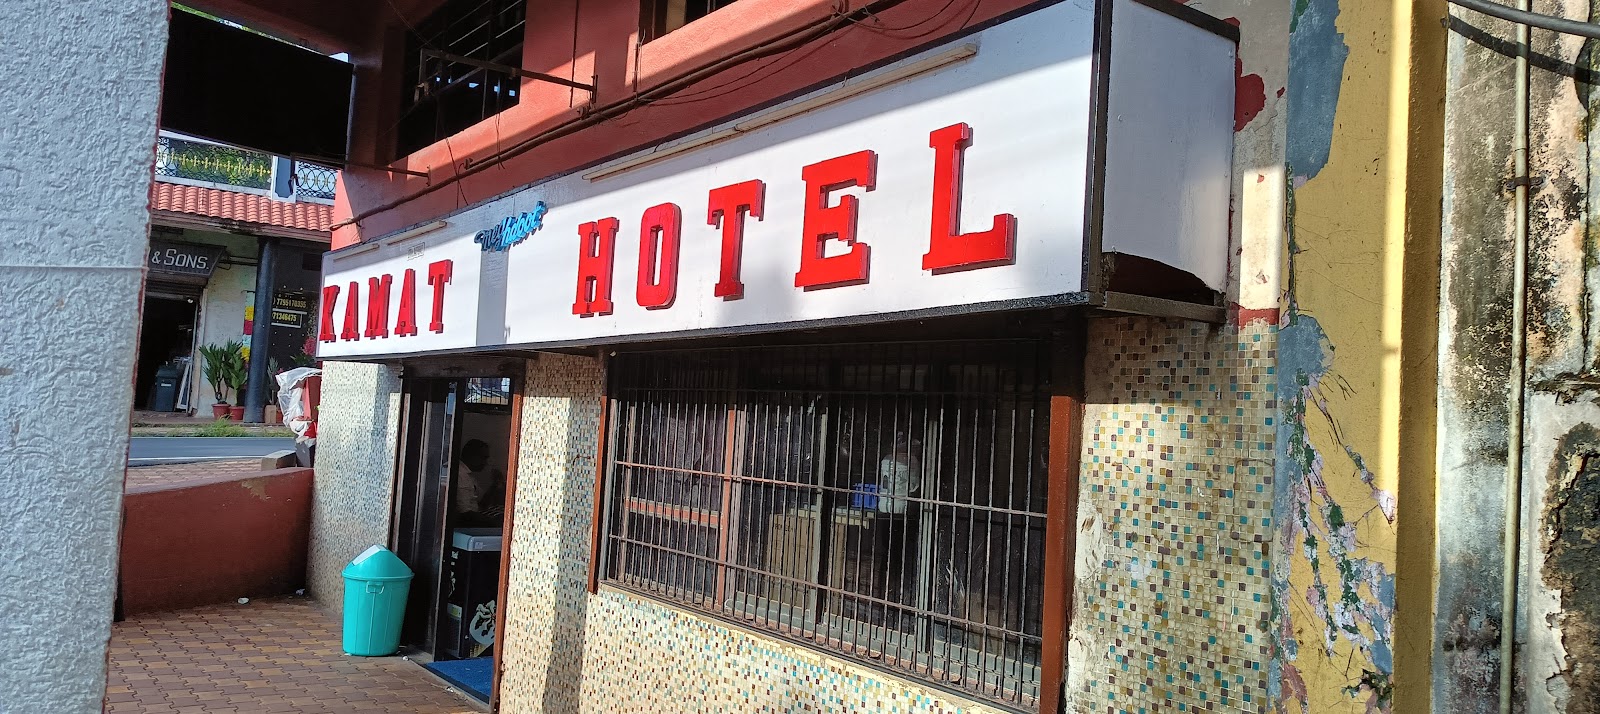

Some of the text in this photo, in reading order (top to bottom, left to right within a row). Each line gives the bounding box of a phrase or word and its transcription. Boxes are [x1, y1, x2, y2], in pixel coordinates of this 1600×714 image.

[151, 250, 161, 265] &
[320, 122, 1016, 342] KAMAT HOTEL
